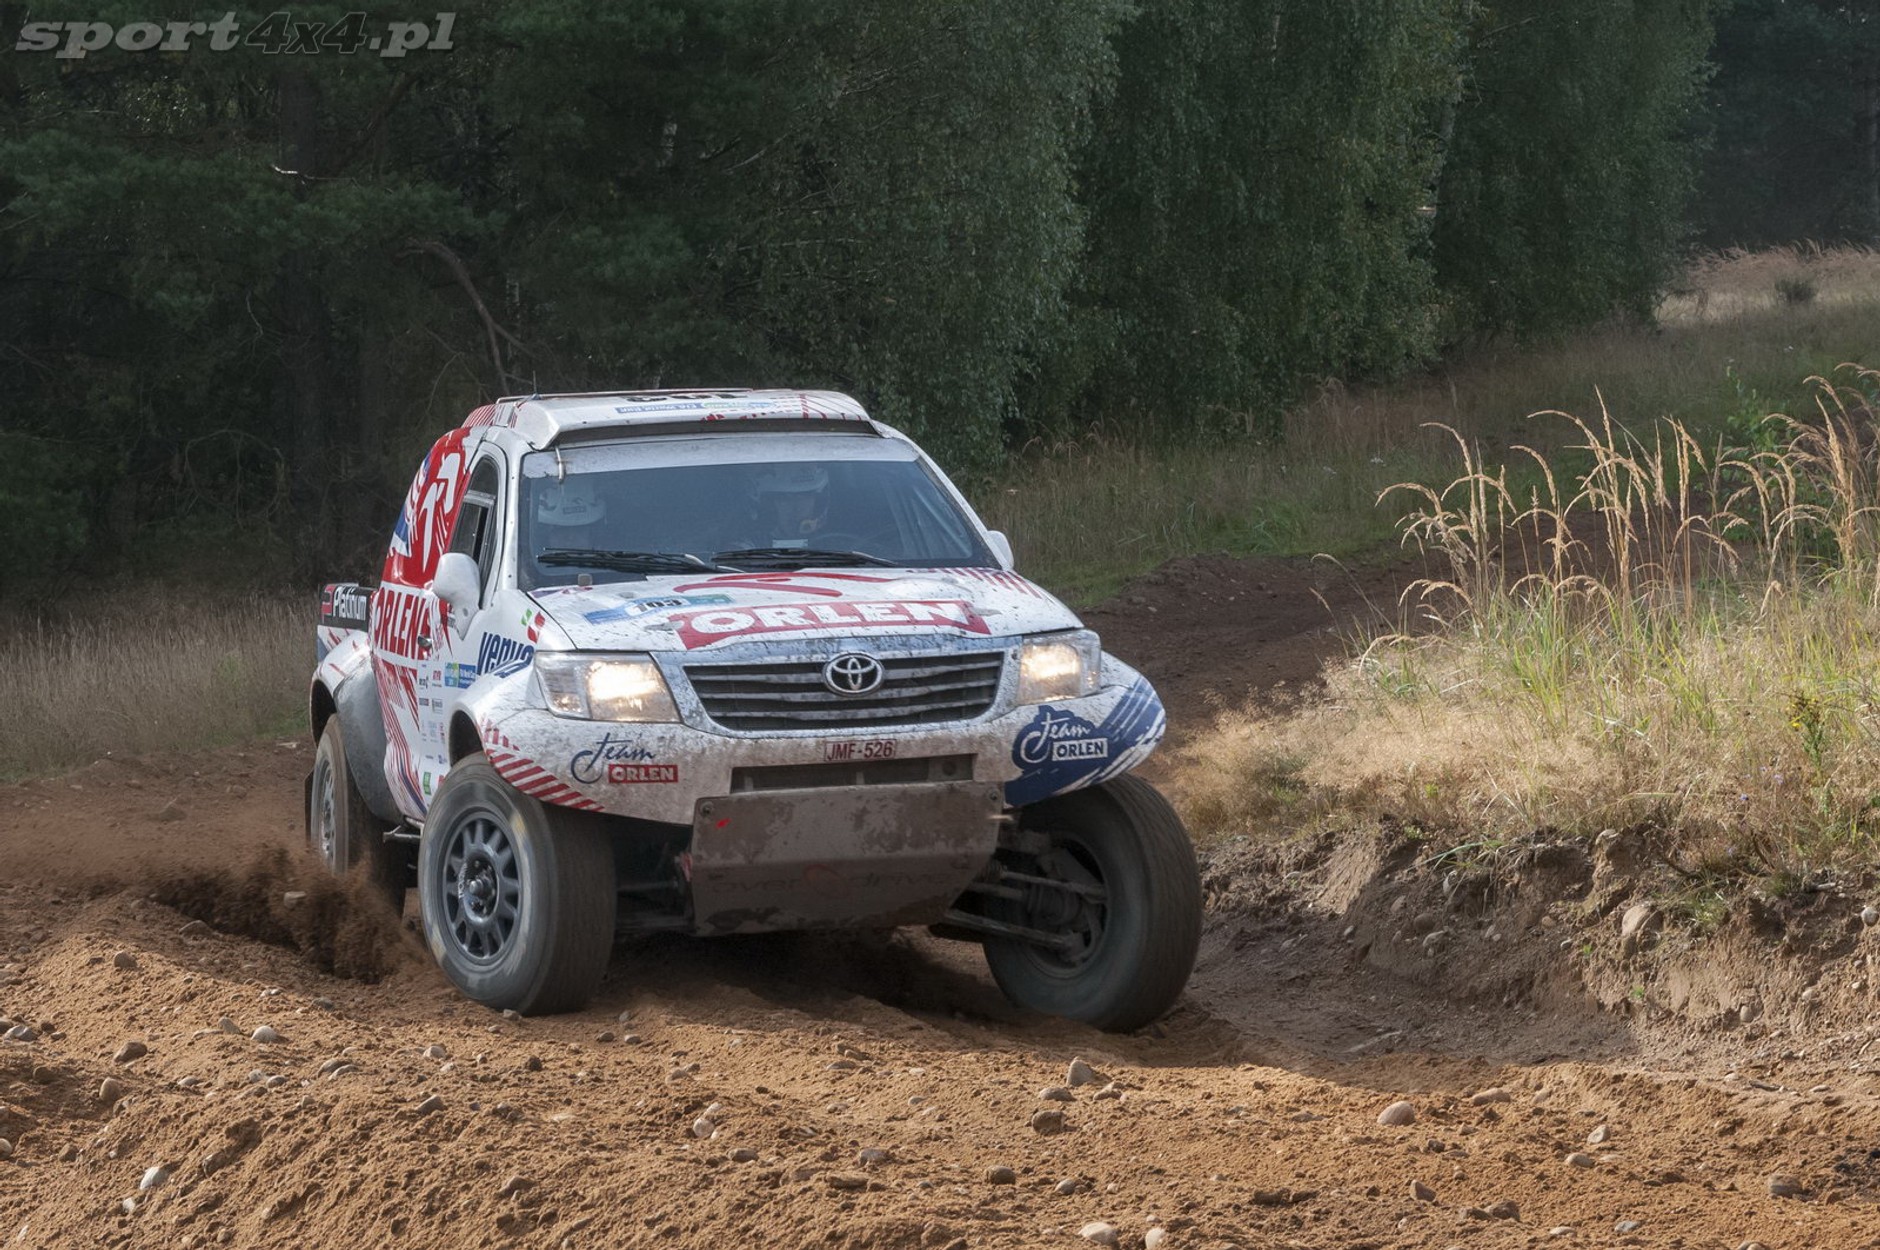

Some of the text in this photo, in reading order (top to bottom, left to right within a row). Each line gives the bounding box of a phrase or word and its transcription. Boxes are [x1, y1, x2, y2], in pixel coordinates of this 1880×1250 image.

[373, 586, 427, 660] ORLEN
[690, 601, 971, 634] ORLEN
[826, 741, 894, 761] JMF-526
[1057, 741, 1105, 758] ORLEN
[611, 766, 675, 781] ORLEN
